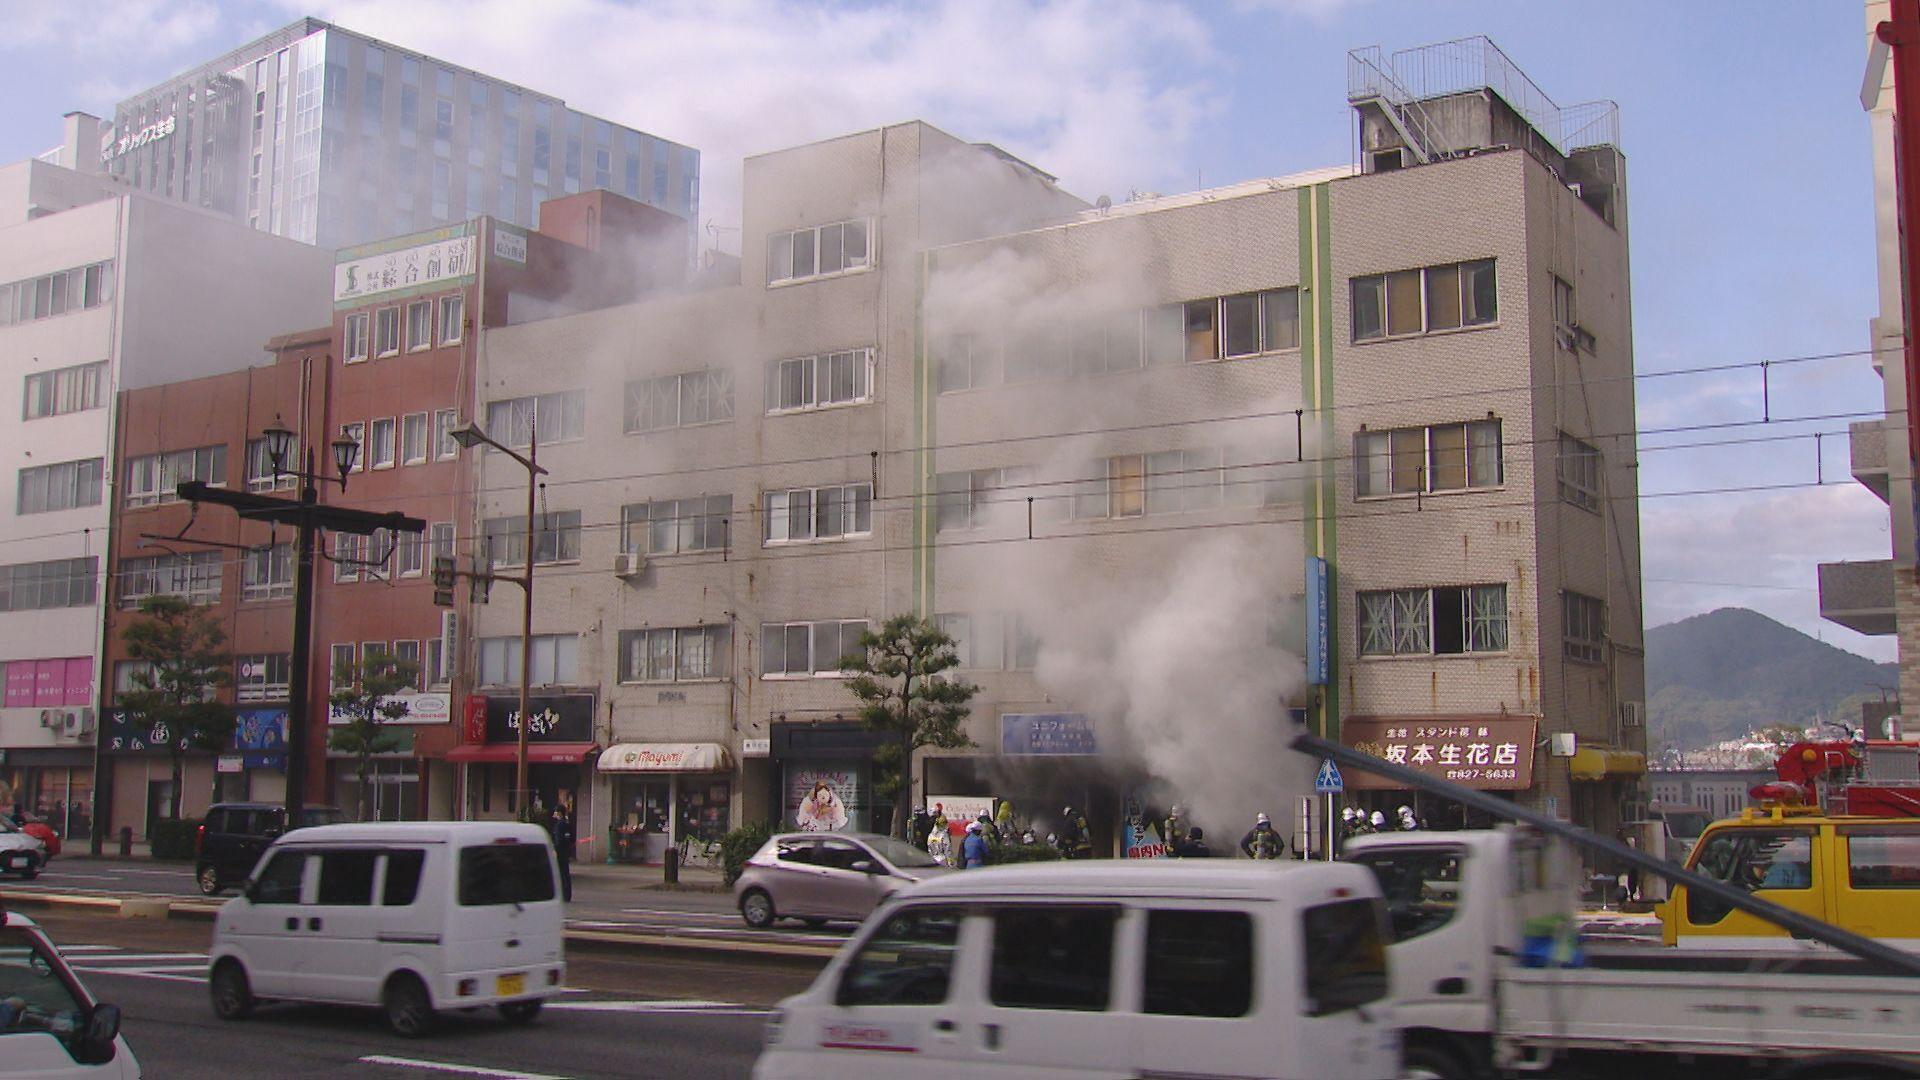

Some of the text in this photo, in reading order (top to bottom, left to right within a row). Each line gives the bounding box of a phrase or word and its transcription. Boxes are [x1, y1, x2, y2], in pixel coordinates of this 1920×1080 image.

[1384, 743, 1518, 765] 坂本生花店
